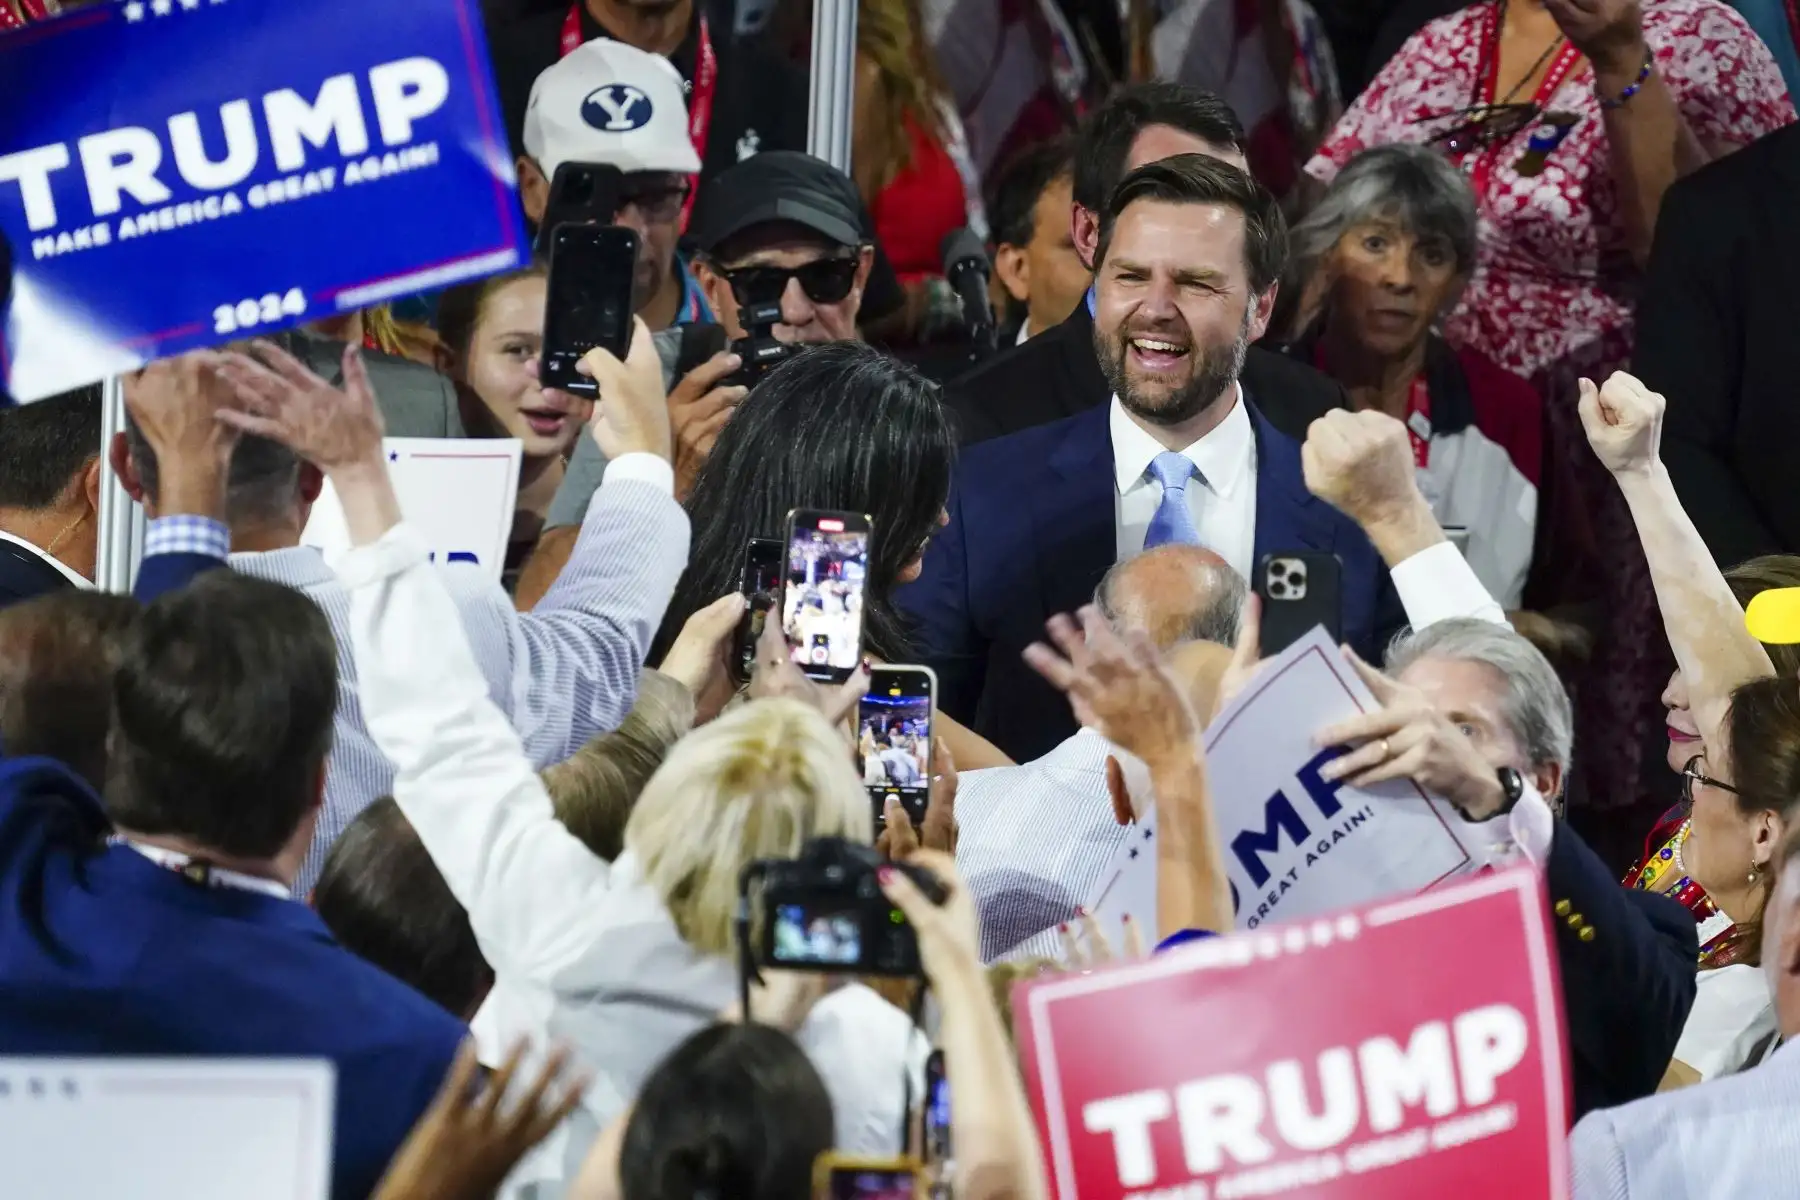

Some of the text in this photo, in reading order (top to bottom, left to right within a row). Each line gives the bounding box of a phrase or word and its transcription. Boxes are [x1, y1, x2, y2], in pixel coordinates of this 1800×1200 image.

[0, 57, 450, 231] TRUMP
[587, 87, 645, 129] Y
[31, 142, 439, 260] MAKE AMERICA GREAT AGAIN!
[213, 287, 307, 334] 2024
[1247, 804, 1375, 930] GREAT AGAIN!
[1083, 1004, 1527, 1188] TRUMP
